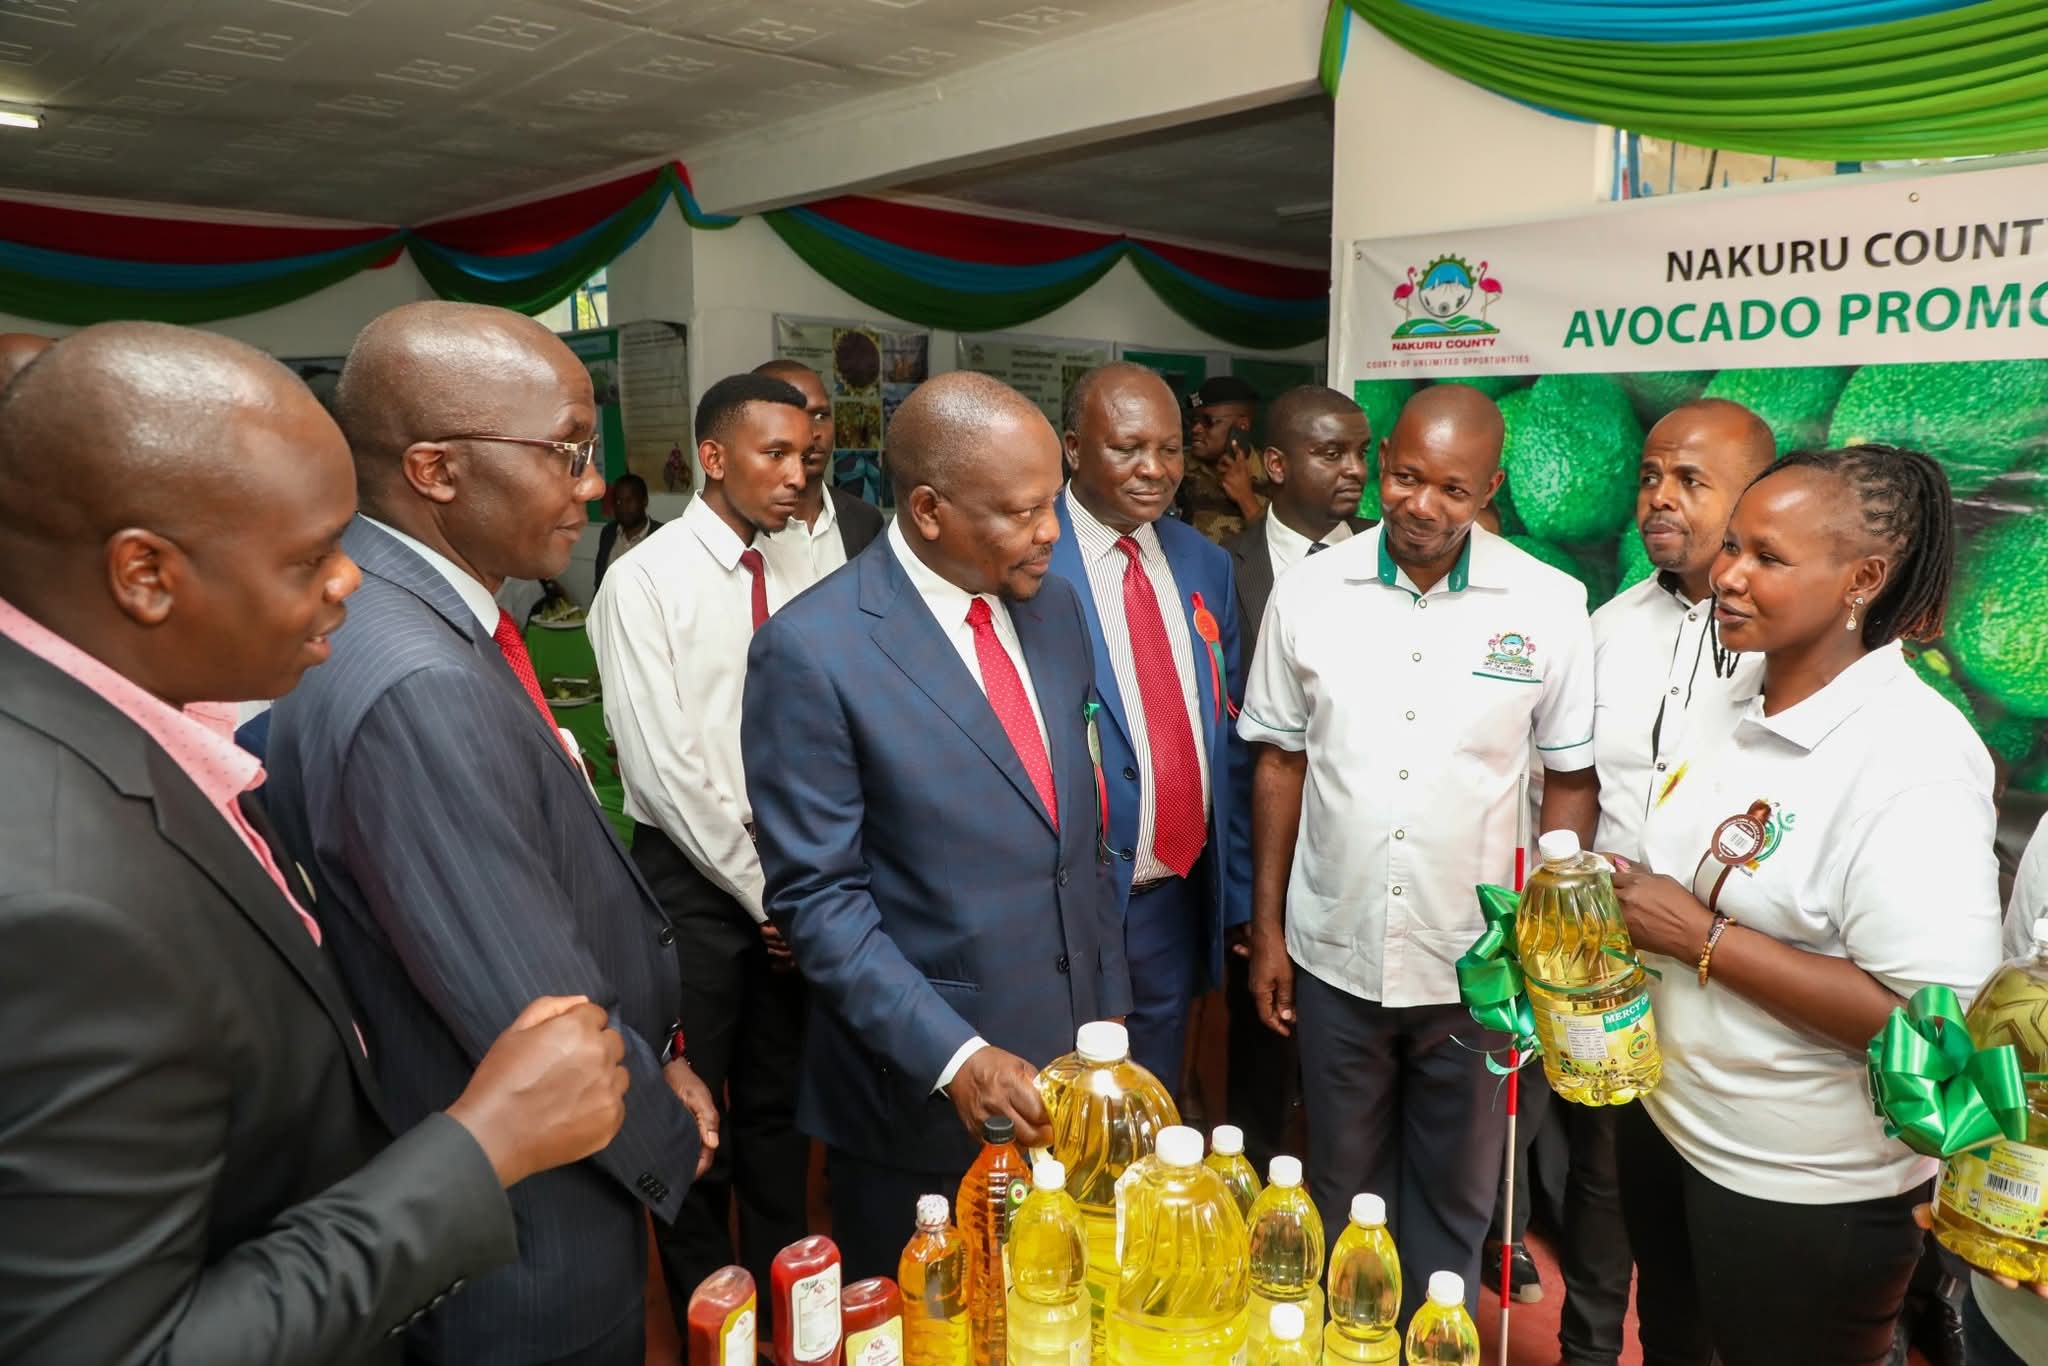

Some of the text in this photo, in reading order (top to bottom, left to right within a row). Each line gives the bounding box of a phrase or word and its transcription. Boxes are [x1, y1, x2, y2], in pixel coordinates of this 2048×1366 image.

[1666, 217, 2048, 283] NAKURU COUNT
[1562, 296, 1821, 348] AVOCADO
[1392, 337, 1497, 351] NAKURU COUNTY
[1366, 355, 1530, 369] COUNTY OF UNLIMITED OPPORTUNITIES
[1604, 1001, 1641, 1024] MERCY
